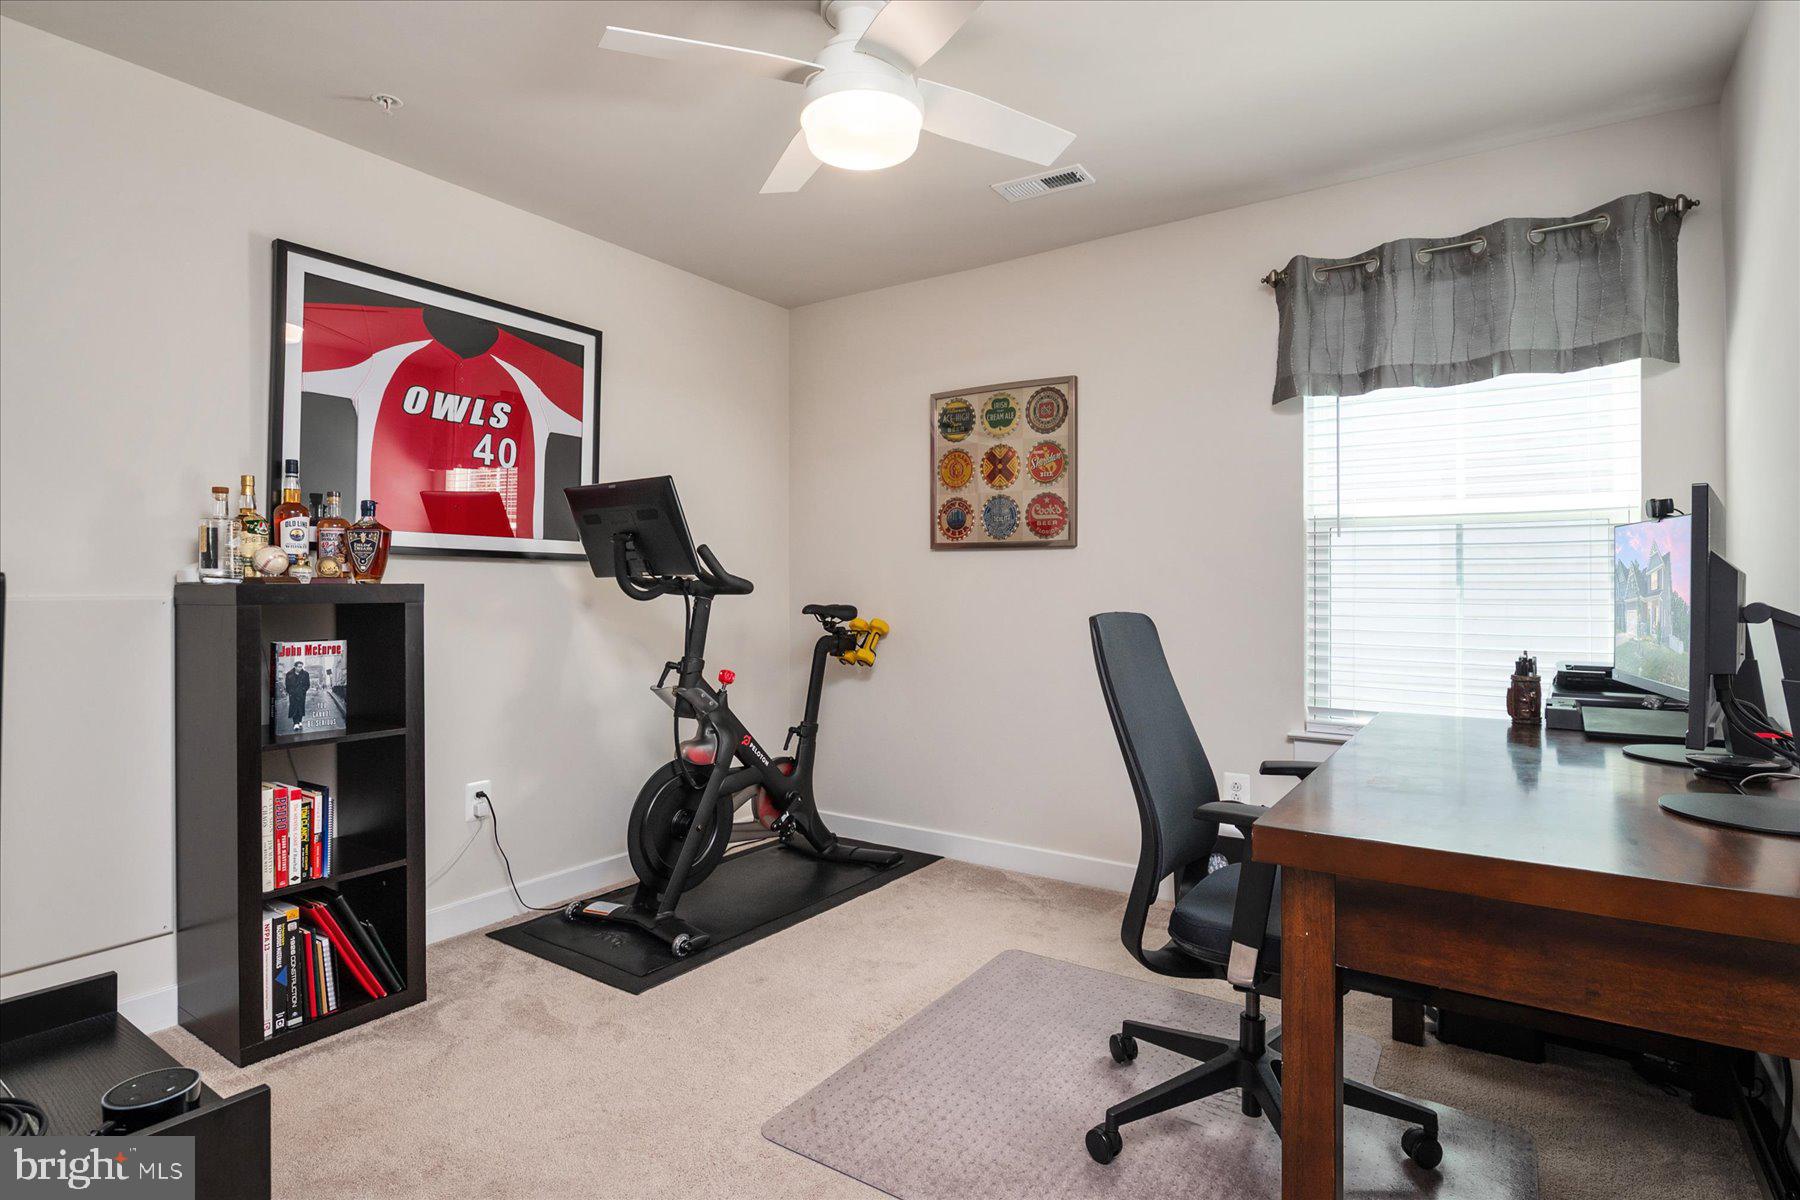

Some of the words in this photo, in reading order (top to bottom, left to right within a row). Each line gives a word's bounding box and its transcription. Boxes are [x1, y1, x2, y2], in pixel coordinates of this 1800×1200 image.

[402, 385, 512, 429] OWLS
[987, 414, 1004, 422] CREAM
[472, 433, 518, 469] 40
[297, 520, 308, 528] LINE
[279, 644, 301, 657] John
[304, 643, 343, 656] McEnroe
[749, 742, 769, 767] PELOTON
[275, 797, 288, 831] PEDRO
[301, 805, 309, 818] TOM
[301, 819, 309, 842] CLANCY
[290, 955, 298, 1008] CONSTRUCTION
